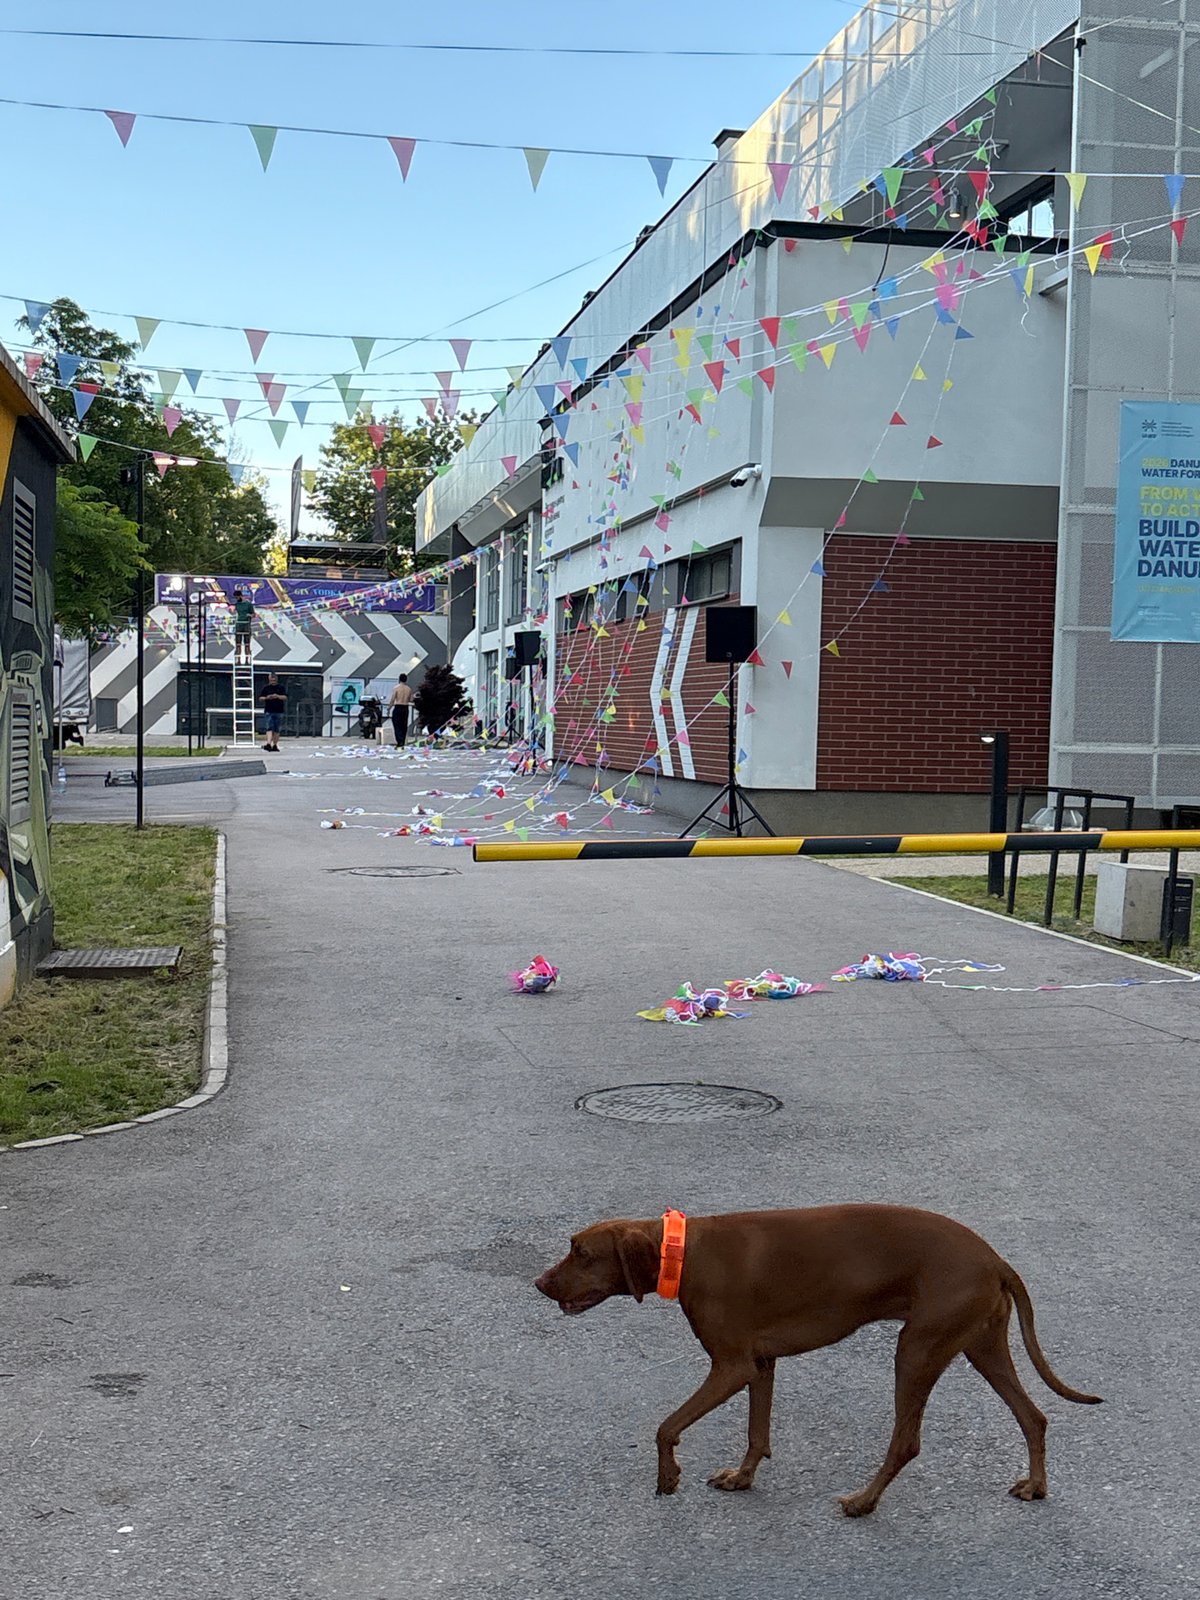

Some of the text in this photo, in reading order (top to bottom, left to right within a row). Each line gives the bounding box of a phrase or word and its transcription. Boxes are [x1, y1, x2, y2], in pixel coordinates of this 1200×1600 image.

[1141, 468, 1179, 478] WATER
[1140, 486, 1188, 500] FROM
[1140, 503, 1163, 516] TO
[1138, 519, 1200, 538] BUILD
[1137, 559, 1200, 578] DANU
